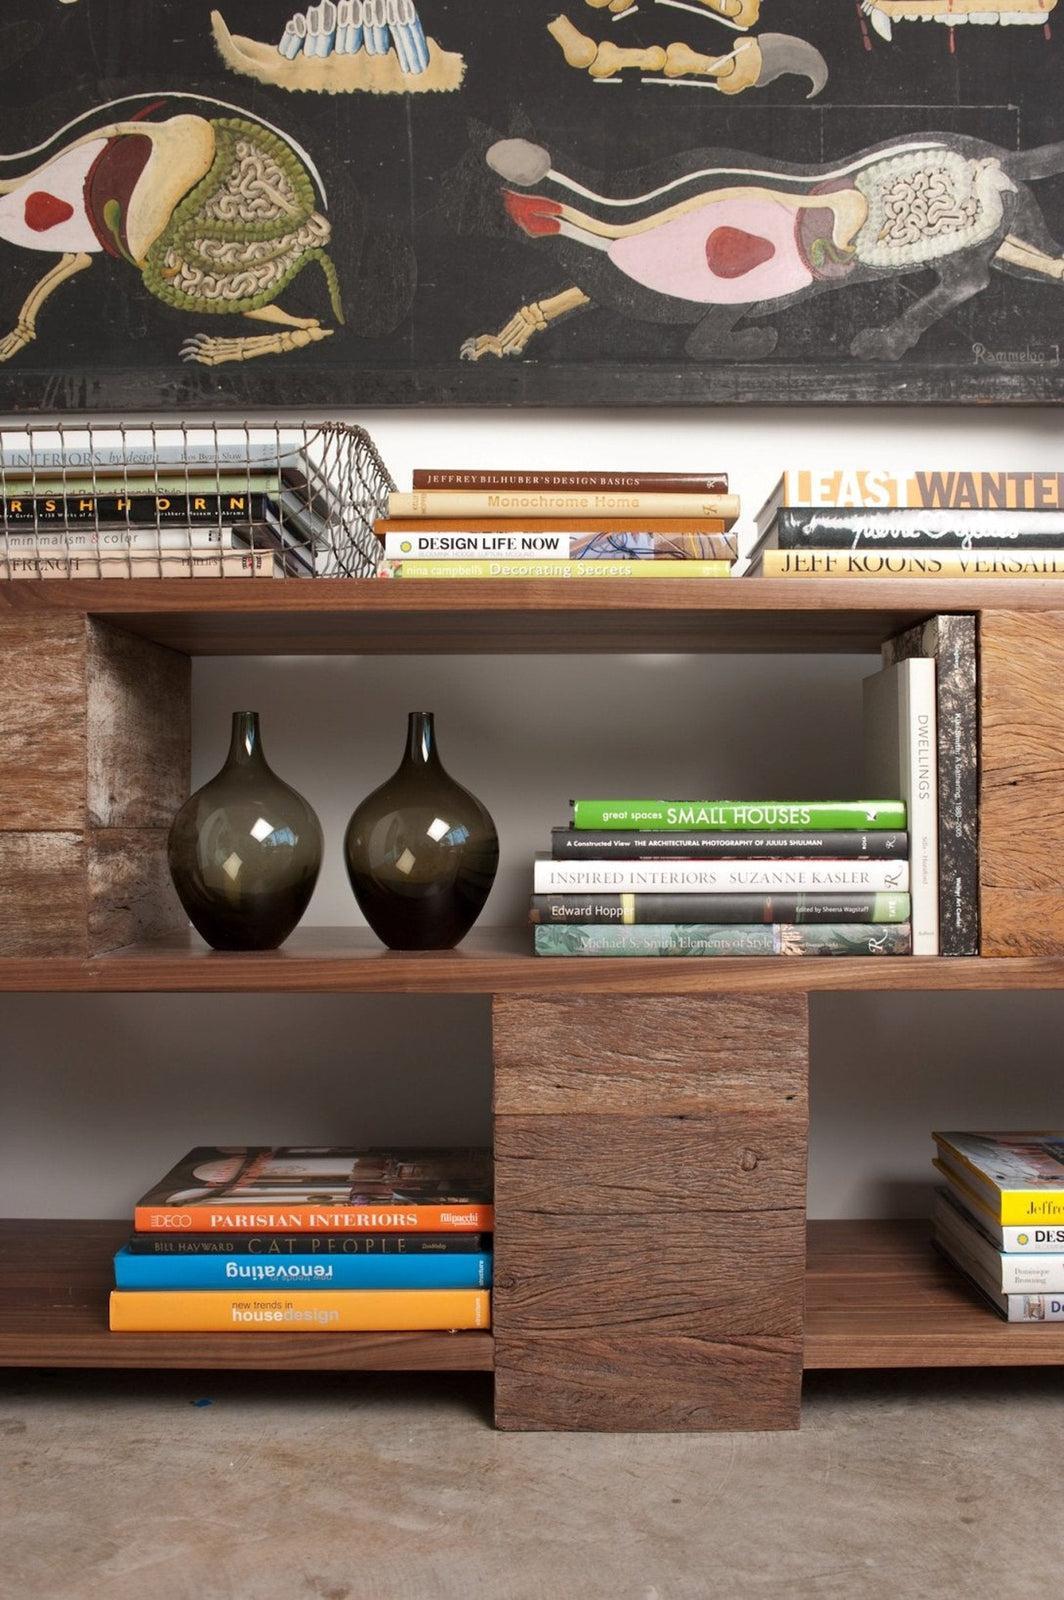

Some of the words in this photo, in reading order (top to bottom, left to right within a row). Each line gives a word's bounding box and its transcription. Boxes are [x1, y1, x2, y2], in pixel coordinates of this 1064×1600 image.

[109, 452, 124, 464] by
[427, 475, 480, 484] JEFFREY
[553, 477, 597, 485] DESIGN
[600, 478, 640, 486] BASICS
[788, 472, 916, 508] LEAST
[915, 472, 1064, 509] WANTE
[488, 495, 588, 508] Monochrome
[595, 496, 640, 508] Home
[103, 533, 139, 544] color
[418, 537, 478, 550] DESIGN
[482, 538, 517, 550] LIFE
[521, 538, 560, 550] NOW
[489, 562, 572, 577] Decorating
[577, 562, 633, 577] Secrets
[781, 554, 837, 572] JEFF
[847, 554, 942, 573] KOONS
[918, 715, 930, 799] DWELLINGS
[602, 811, 628, 821] great
[631, 812, 663, 821] spaces
[666, 807, 726, 825] SMALL
[733, 807, 811, 825] HOUSES
[648, 839, 700, 847] ARCHITECTURAL
[701, 839, 752, 847] PHOTOGRAPHY
[550, 872, 624, 885] INSPIRED
[630, 872, 717, 885] INTERIORS
[729, 872, 806, 884] SUZANNE
[812, 872, 870, 883] KASLER
[551, 905, 593, 916] Edward
[814, 905, 822, 915] by
[580, 937, 627, 949] Michael
[644, 937, 677, 949] Smith
[747, 936, 773, 950] Style
[210, 1214, 302, 1227] PARISIAN
[309, 1213, 418, 1226] INTERIORS
[1035, 1230, 1064, 1243] DES
[154, 1242, 174, 1252] BILL
[178, 1242, 234, 1252] HAYWARD
[248, 1238, 297, 1254] CAT
[311, 1238, 407, 1253] PEOPLE
[225, 1261, 334, 1280] renovating
[231, 1302, 251, 1310] new
[253, 1301, 283, 1309] trends
[285, 1301, 293, 1309] in
